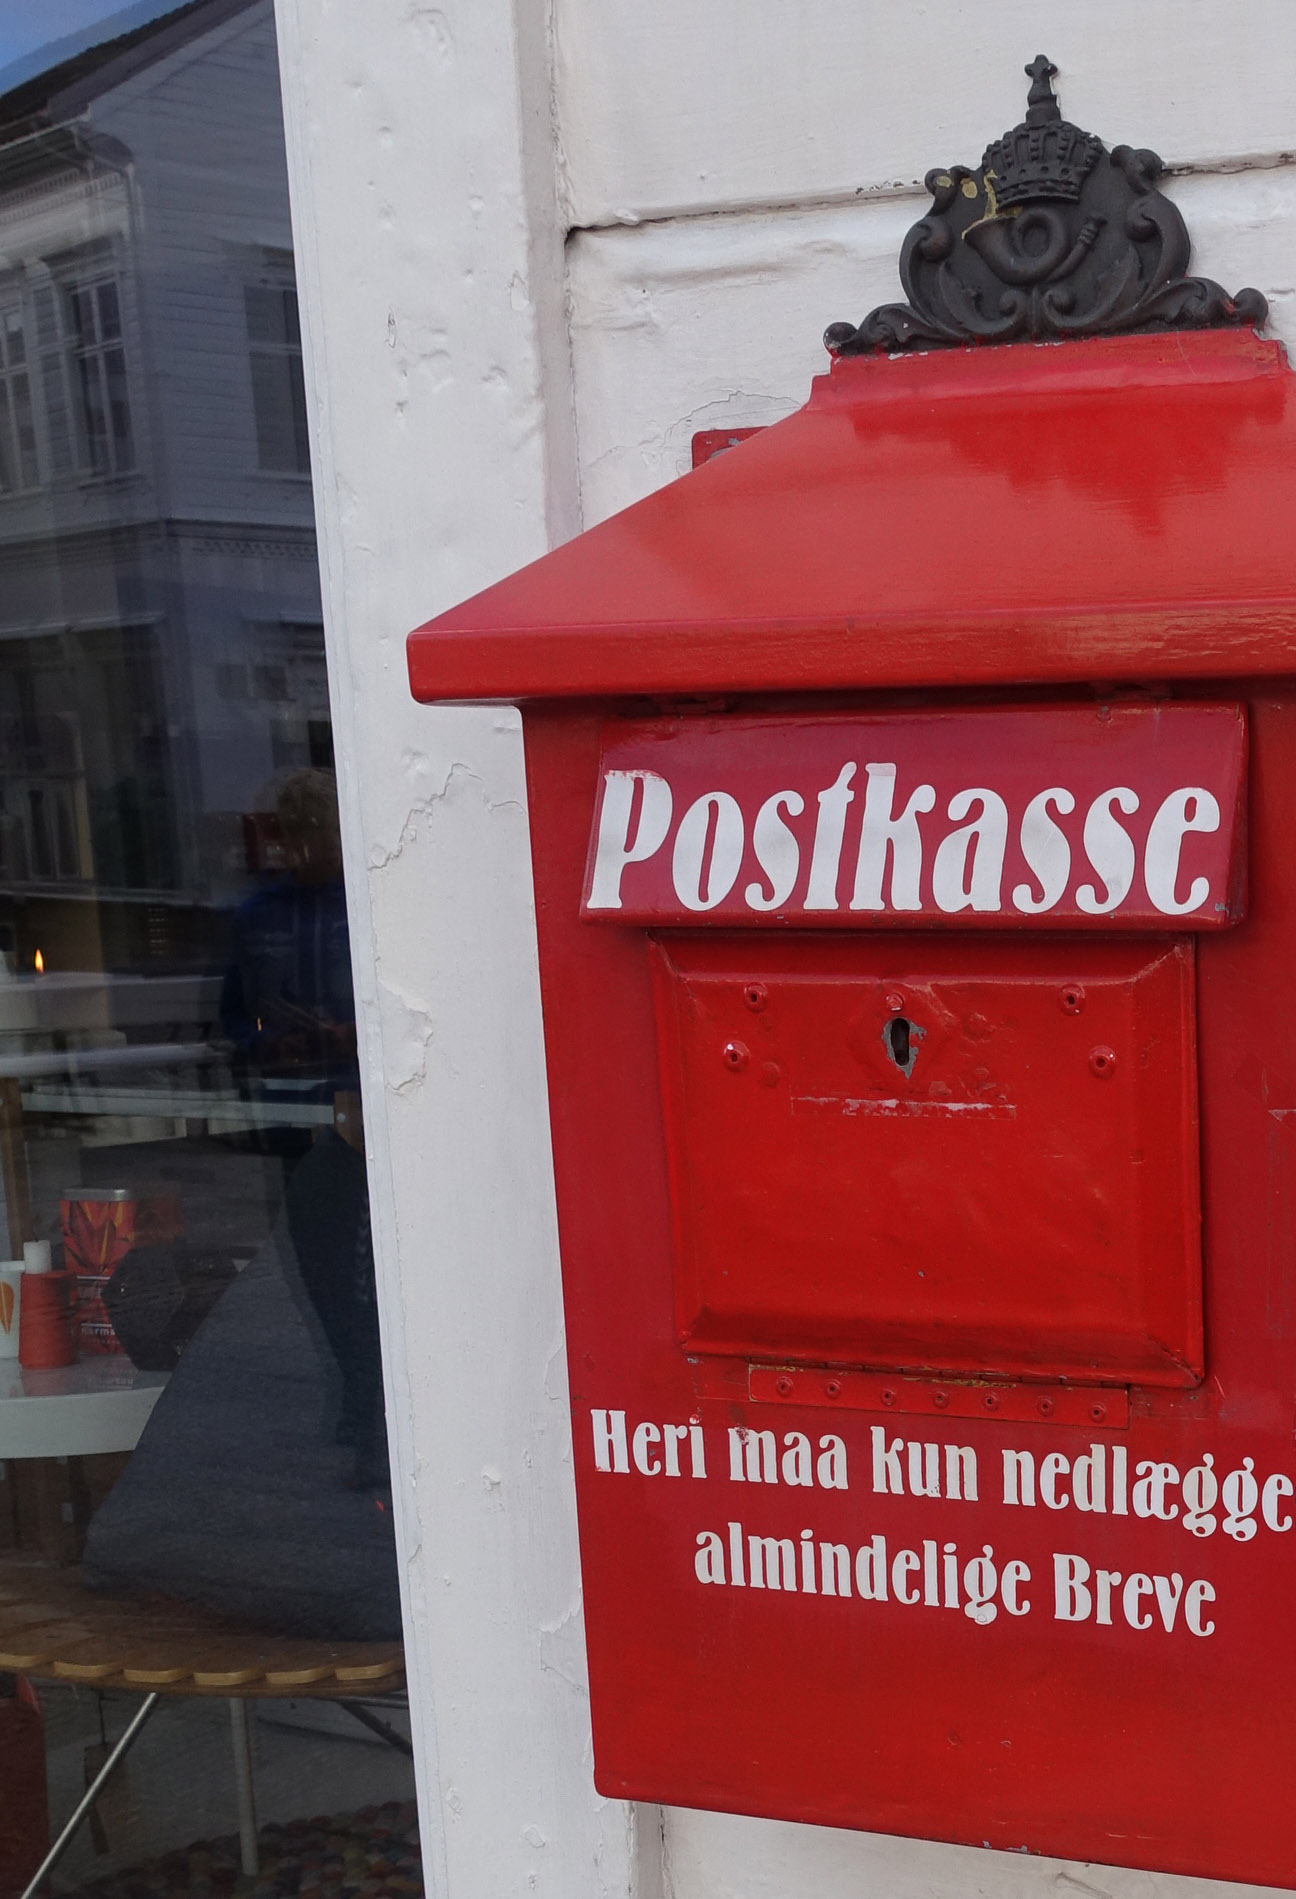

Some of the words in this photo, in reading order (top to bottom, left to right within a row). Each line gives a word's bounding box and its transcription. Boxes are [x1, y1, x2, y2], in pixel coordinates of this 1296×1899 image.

[586, 761, 1221, 916] Postkasse
[590, 1408, 708, 1479] Heri
[727, 1426, 849, 1490] maa
[870, 1425, 979, 1502] kun
[694, 1521, 1031, 1626] almindelige
[1052, 1552, 1216, 1637] Breve
